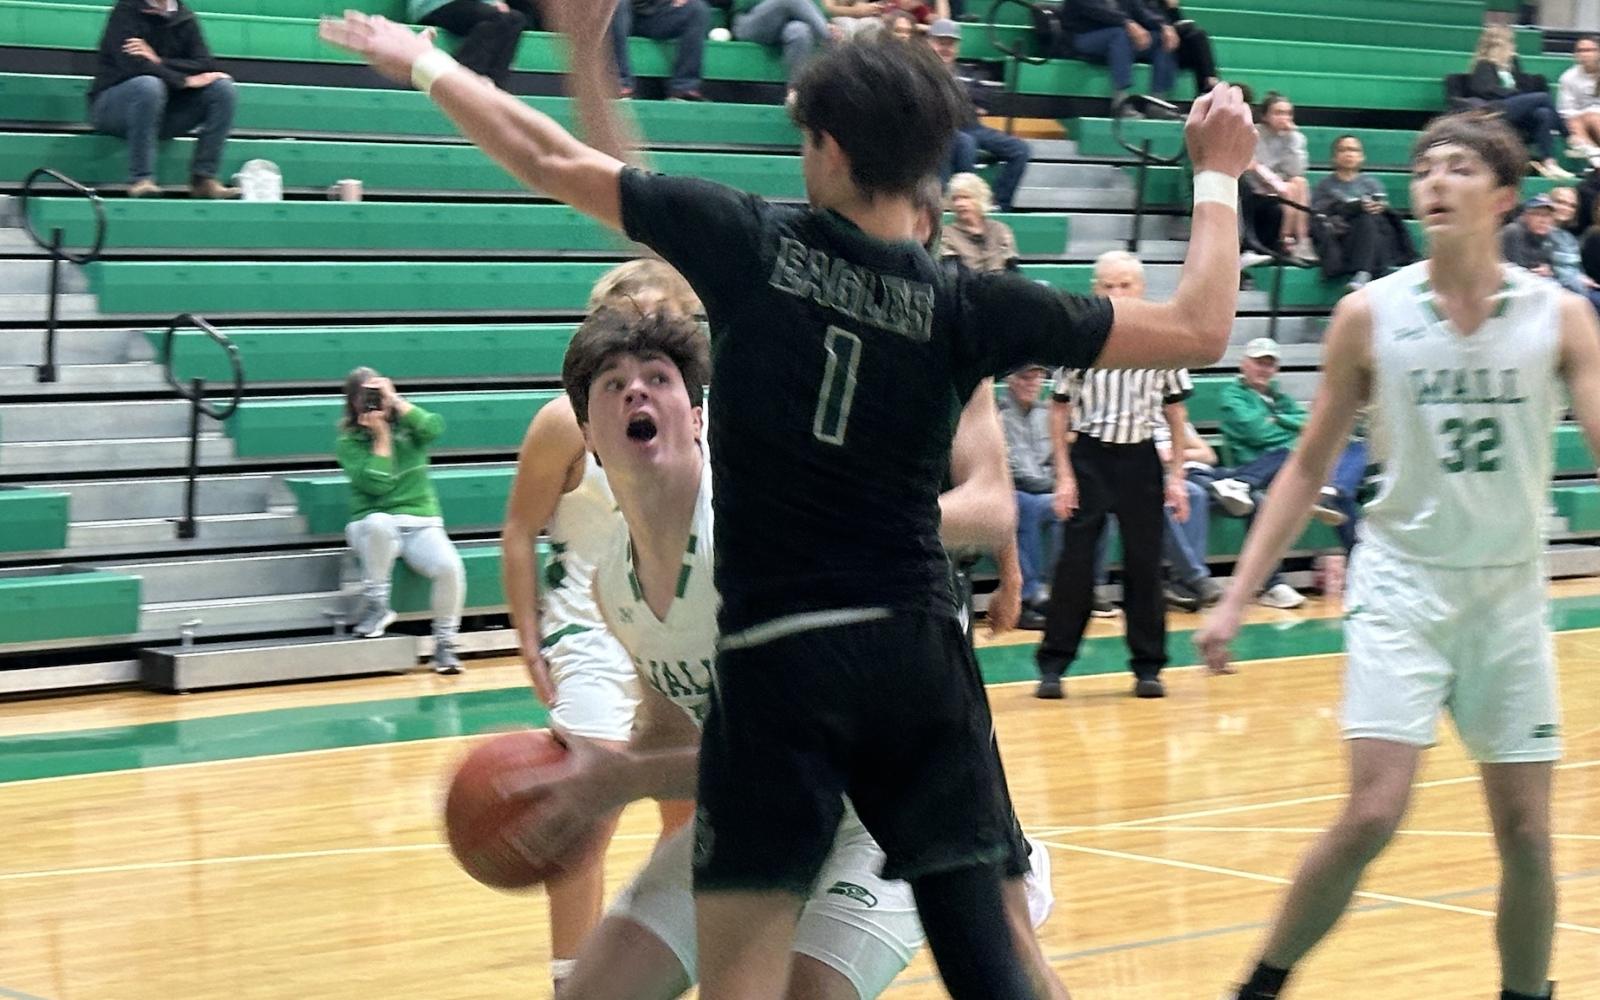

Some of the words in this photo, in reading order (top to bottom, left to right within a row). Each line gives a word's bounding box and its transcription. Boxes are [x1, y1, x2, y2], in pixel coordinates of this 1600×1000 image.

[768, 236, 935, 342] EAGLES
[812, 324, 862, 447] 1
[1408, 368, 1527, 405] WALL
[1439, 417, 1503, 473] 32
